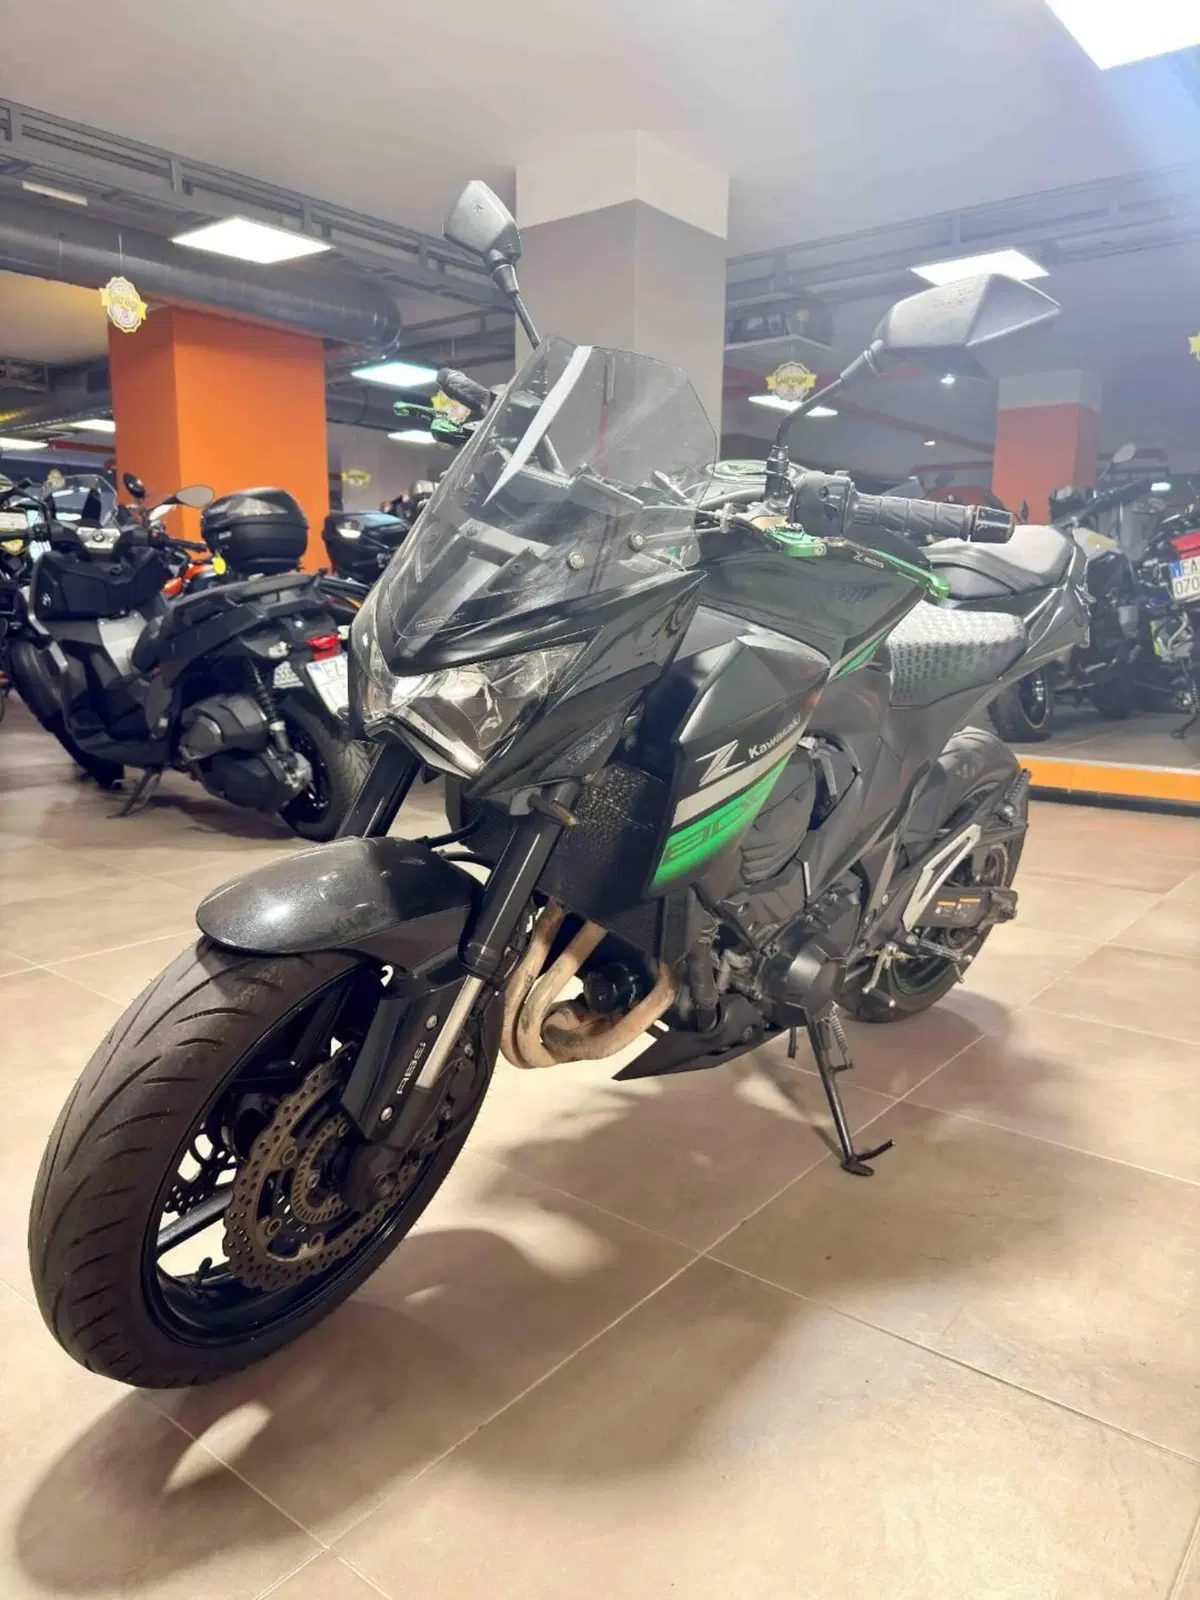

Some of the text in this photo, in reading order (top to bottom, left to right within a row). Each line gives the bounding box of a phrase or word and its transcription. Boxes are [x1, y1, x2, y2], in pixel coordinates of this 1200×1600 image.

[695, 713, 801, 787] Z Kawasaki
[396, 1042, 426, 1095] ABS
